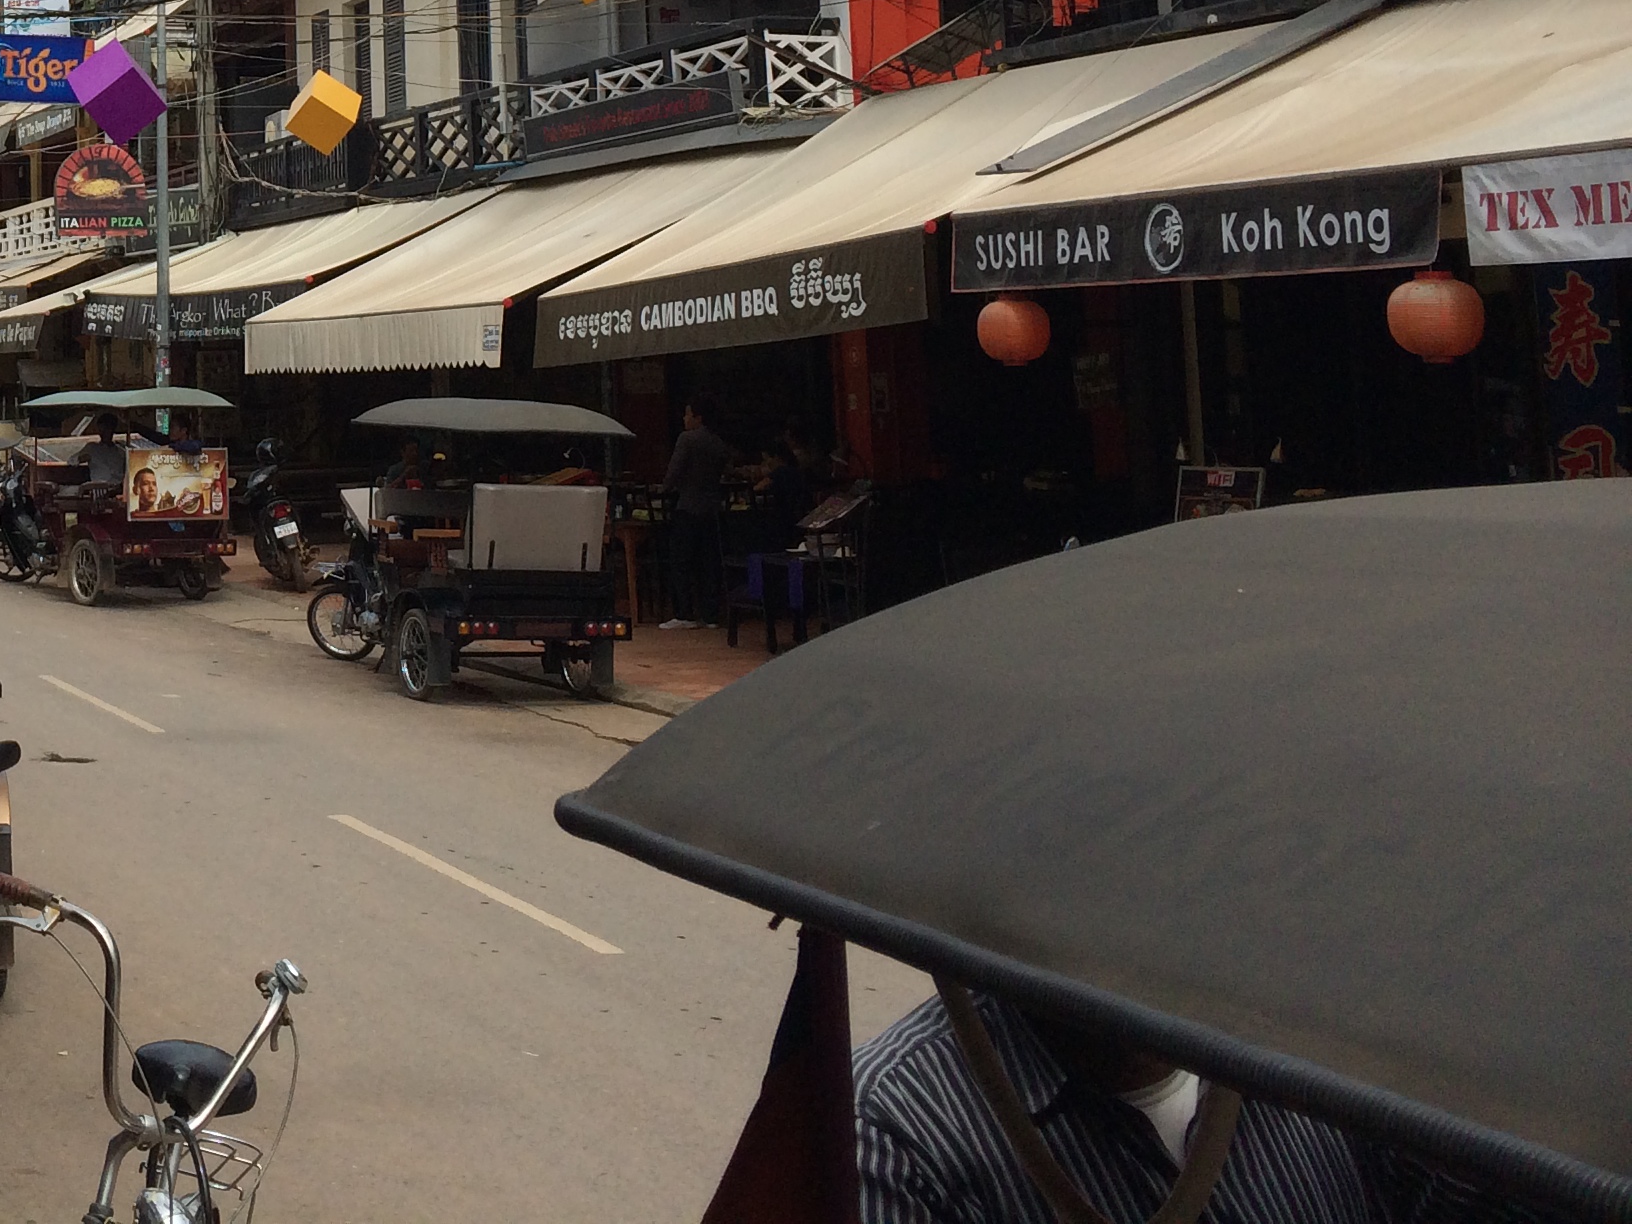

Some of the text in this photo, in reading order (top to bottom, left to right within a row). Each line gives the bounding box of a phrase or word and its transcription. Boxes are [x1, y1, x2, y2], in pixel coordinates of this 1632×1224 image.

[0, 47, 79, 93] Tiger
[60, 216, 144, 229] ITALIAN PIZZA
[1221, 206, 1391, 254] Koh Kong
[1479, 187, 1560, 232] TEX
[975, 225, 1111, 271] SUSHI BAR
[640, 286, 779, 333] CAMBODIAN BBQ
